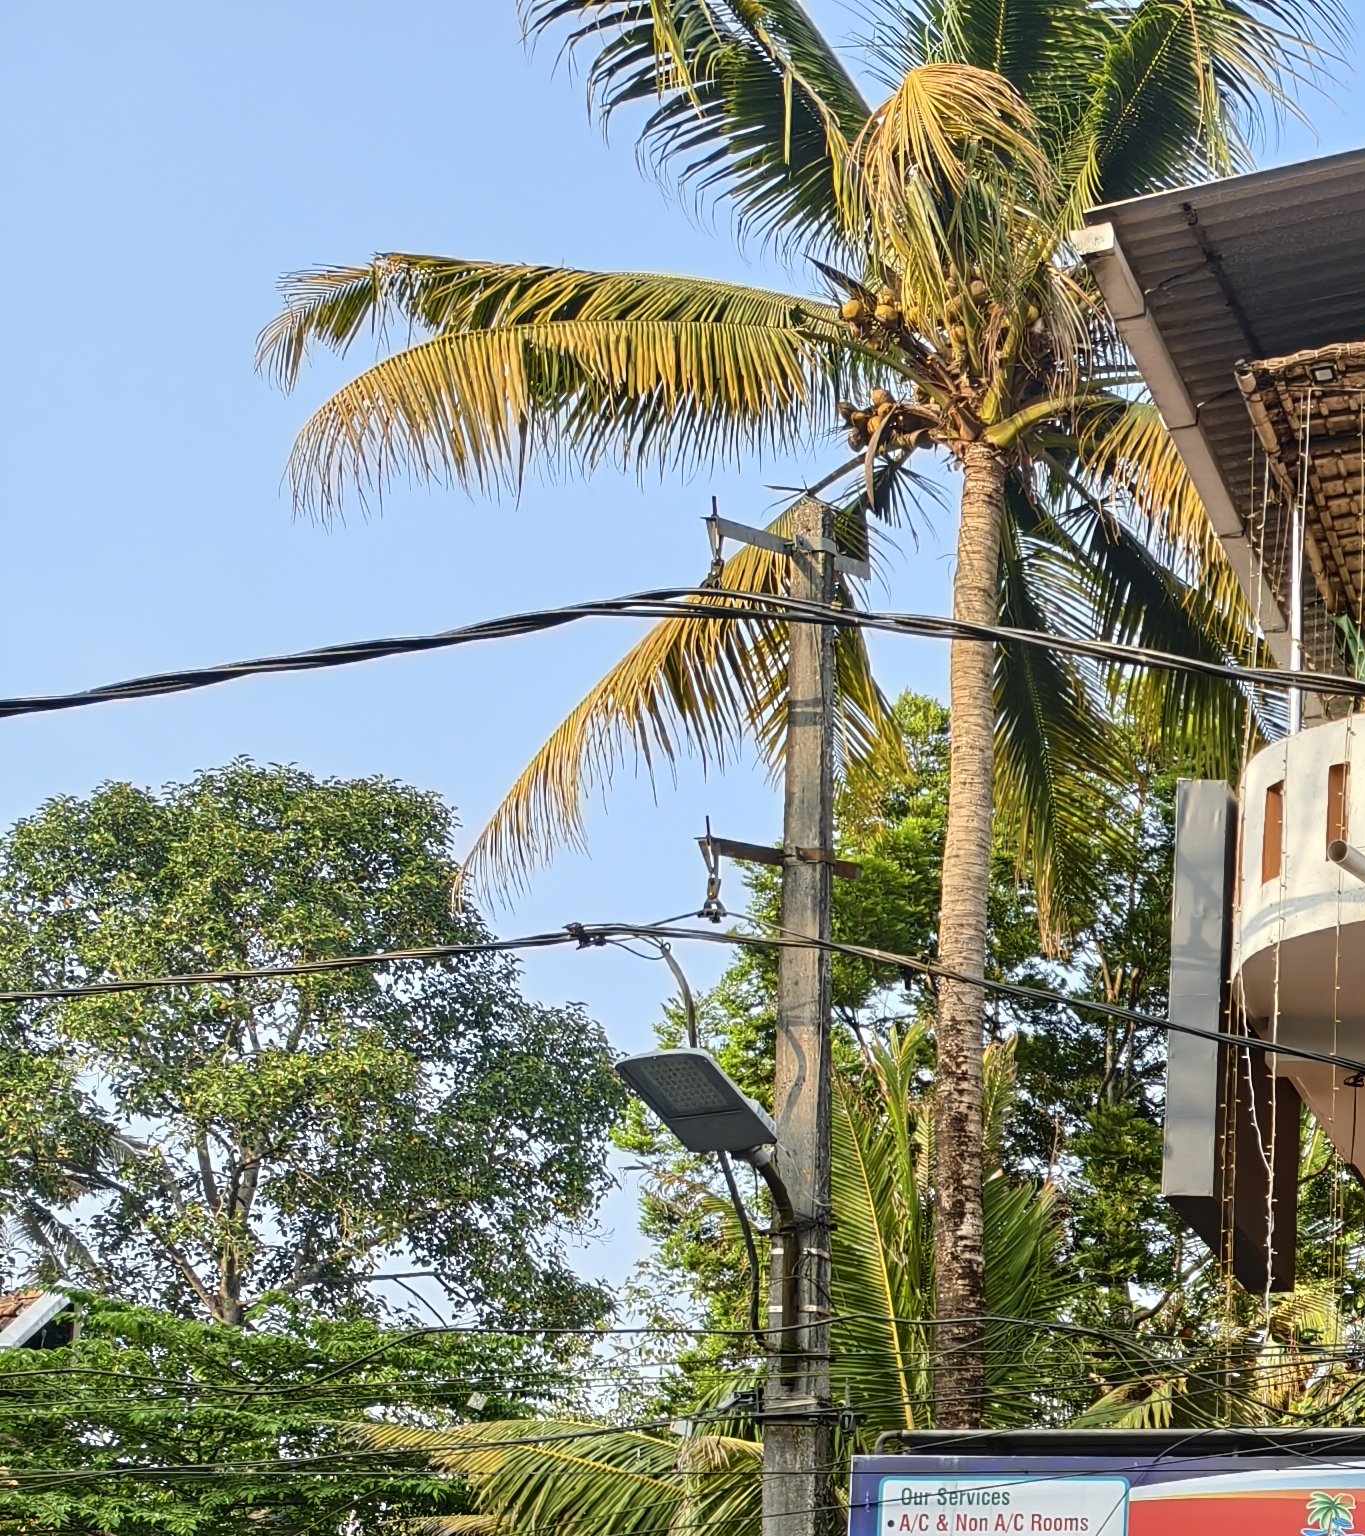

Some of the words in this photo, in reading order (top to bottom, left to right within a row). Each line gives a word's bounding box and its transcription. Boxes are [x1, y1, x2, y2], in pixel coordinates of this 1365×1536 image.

[901, 1487, 930, 1506] Our
[937, 1488, 1010, 1506] Services
[956, 1514, 988, 1531] Non
[1031, 1514, 1089, 1531] Rooms
